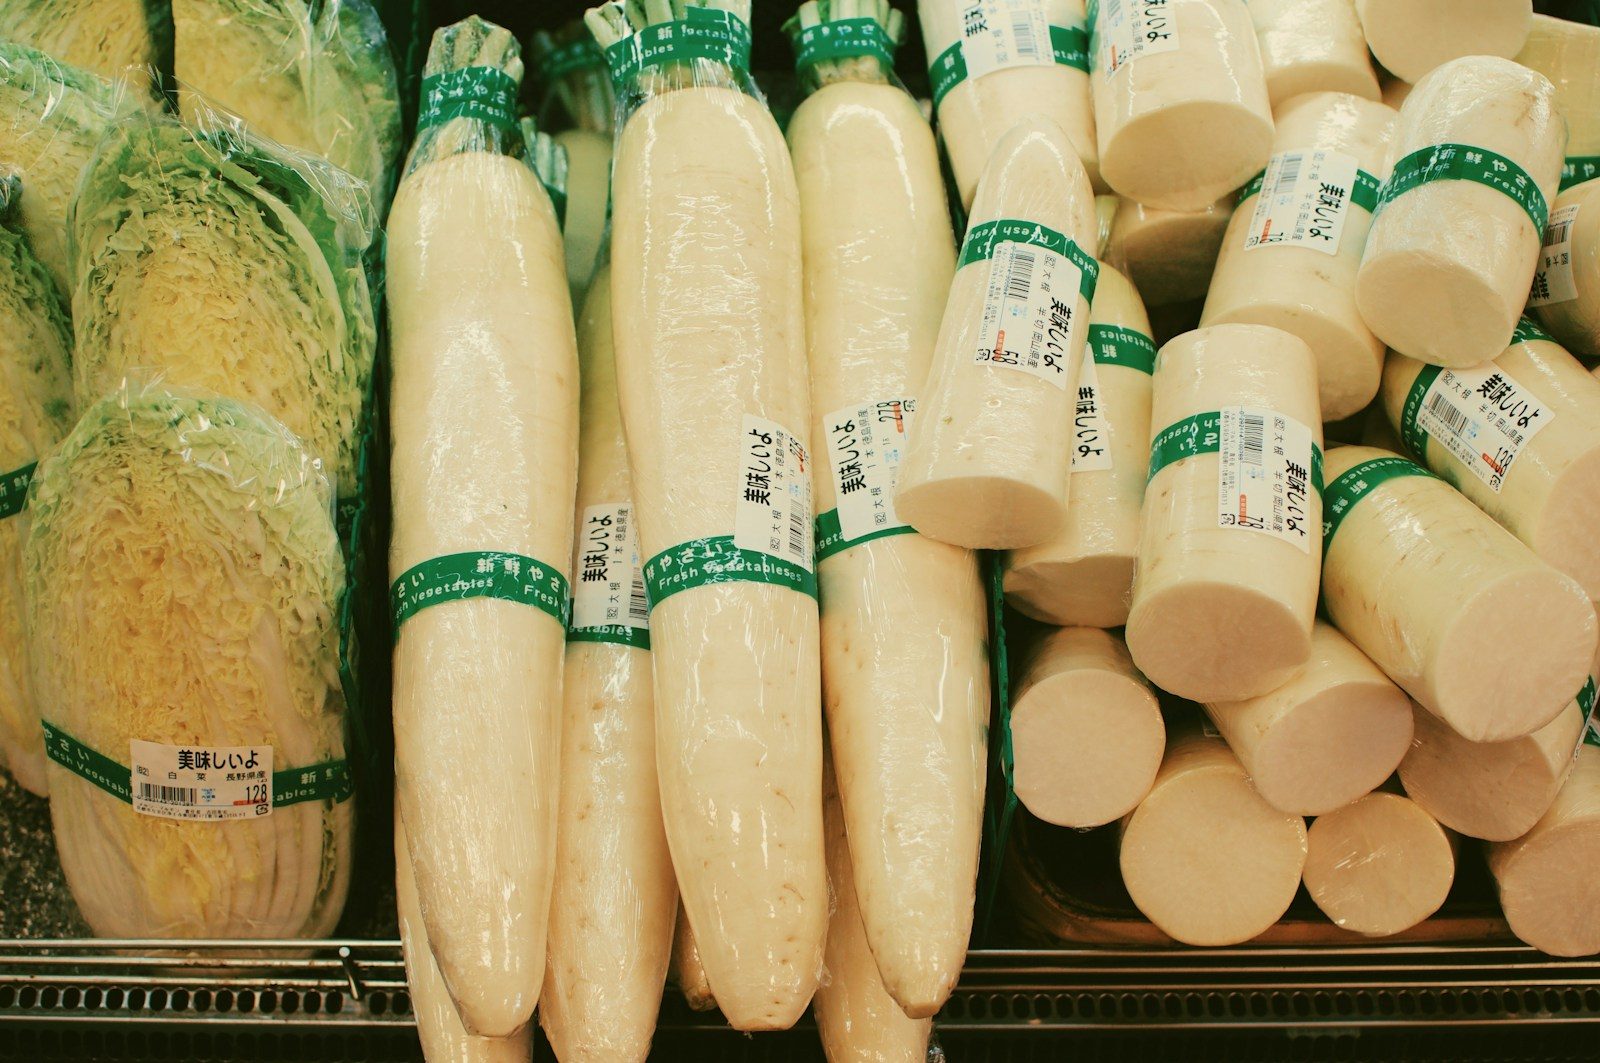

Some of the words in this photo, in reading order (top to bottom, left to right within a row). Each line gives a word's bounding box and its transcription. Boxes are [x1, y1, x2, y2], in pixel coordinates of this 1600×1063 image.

[1483, 171, 1525, 201] Fresh
[1309, 182, 1346, 241] 美味しいよ
[1044, 297, 1072, 374] 美味しいよ
[992, 349, 1019, 365] 58
[876, 400, 903, 423] 278
[1452, 381, 1472, 400] 大根
[1494, 416, 1524, 447] 岡山県産
[1476, 373, 1540, 428] 美味しいよ
[1076, 387, 1104, 457] 美味しいよ
[743, 428, 773, 506] 美味しいよ
[832, 419, 867, 496] 美味しいよ
[1490, 446, 1514, 478] 128
[871, 487, 884, 509] 大根
[1285, 459, 1308, 537] 美味しいよ
[771, 510, 783, 534] 大根
[1238, 514, 1264, 530] 78
[581, 514, 613, 583] 美味しいよ
[412, 579, 494, 604] Vegetables
[659, 567, 699, 590] Fresh
[609, 582, 620, 604] 大根
[178, 749, 260, 771] 美味しいよ
[77, 760, 133, 798] Vegetabl
[226, 770, 266, 782] 長野県産
[246, 783, 268, 804] 128
[274, 787, 316, 802] ables
